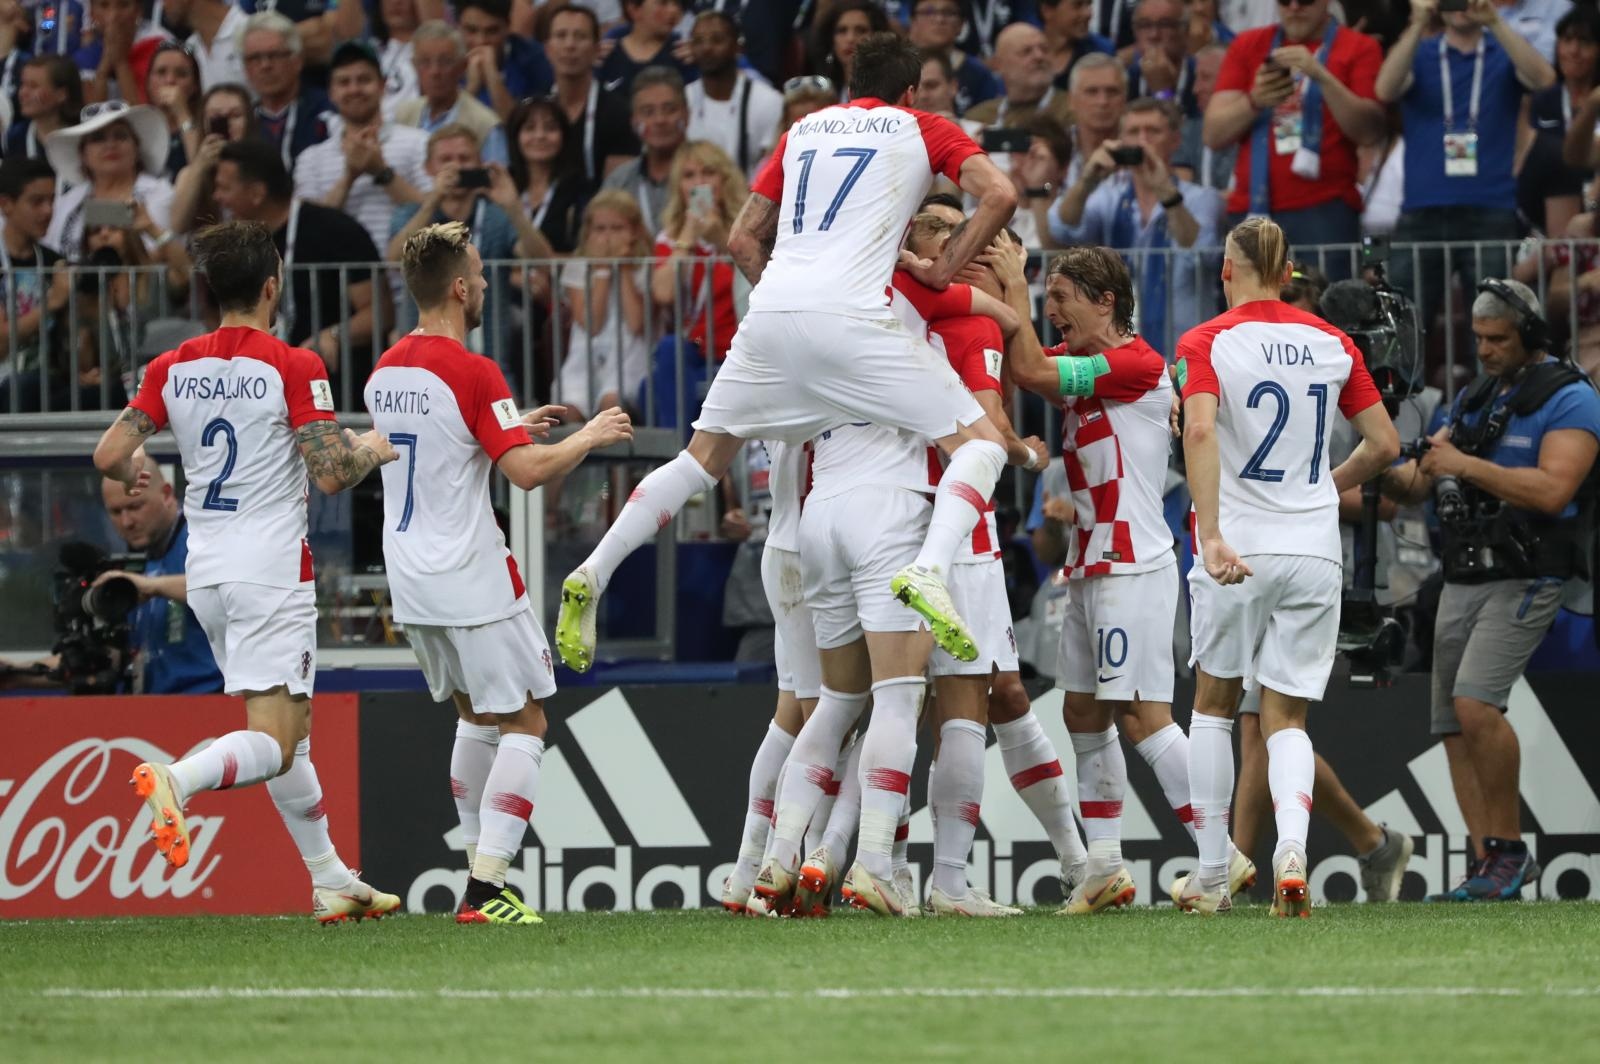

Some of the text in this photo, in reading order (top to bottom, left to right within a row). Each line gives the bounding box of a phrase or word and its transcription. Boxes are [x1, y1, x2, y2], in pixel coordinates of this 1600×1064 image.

[792, 147, 878, 235] 17
[1260, 342, 1315, 366] VIDA
[173, 375, 267, 400] VRSALJKO
[374, 387, 430, 415] RAKITIĆ
[201, 417, 239, 512] 2
[1238, 380, 1328, 485] 21
[388, 432, 418, 532] 7
[1097, 627, 1128, 669] 10
